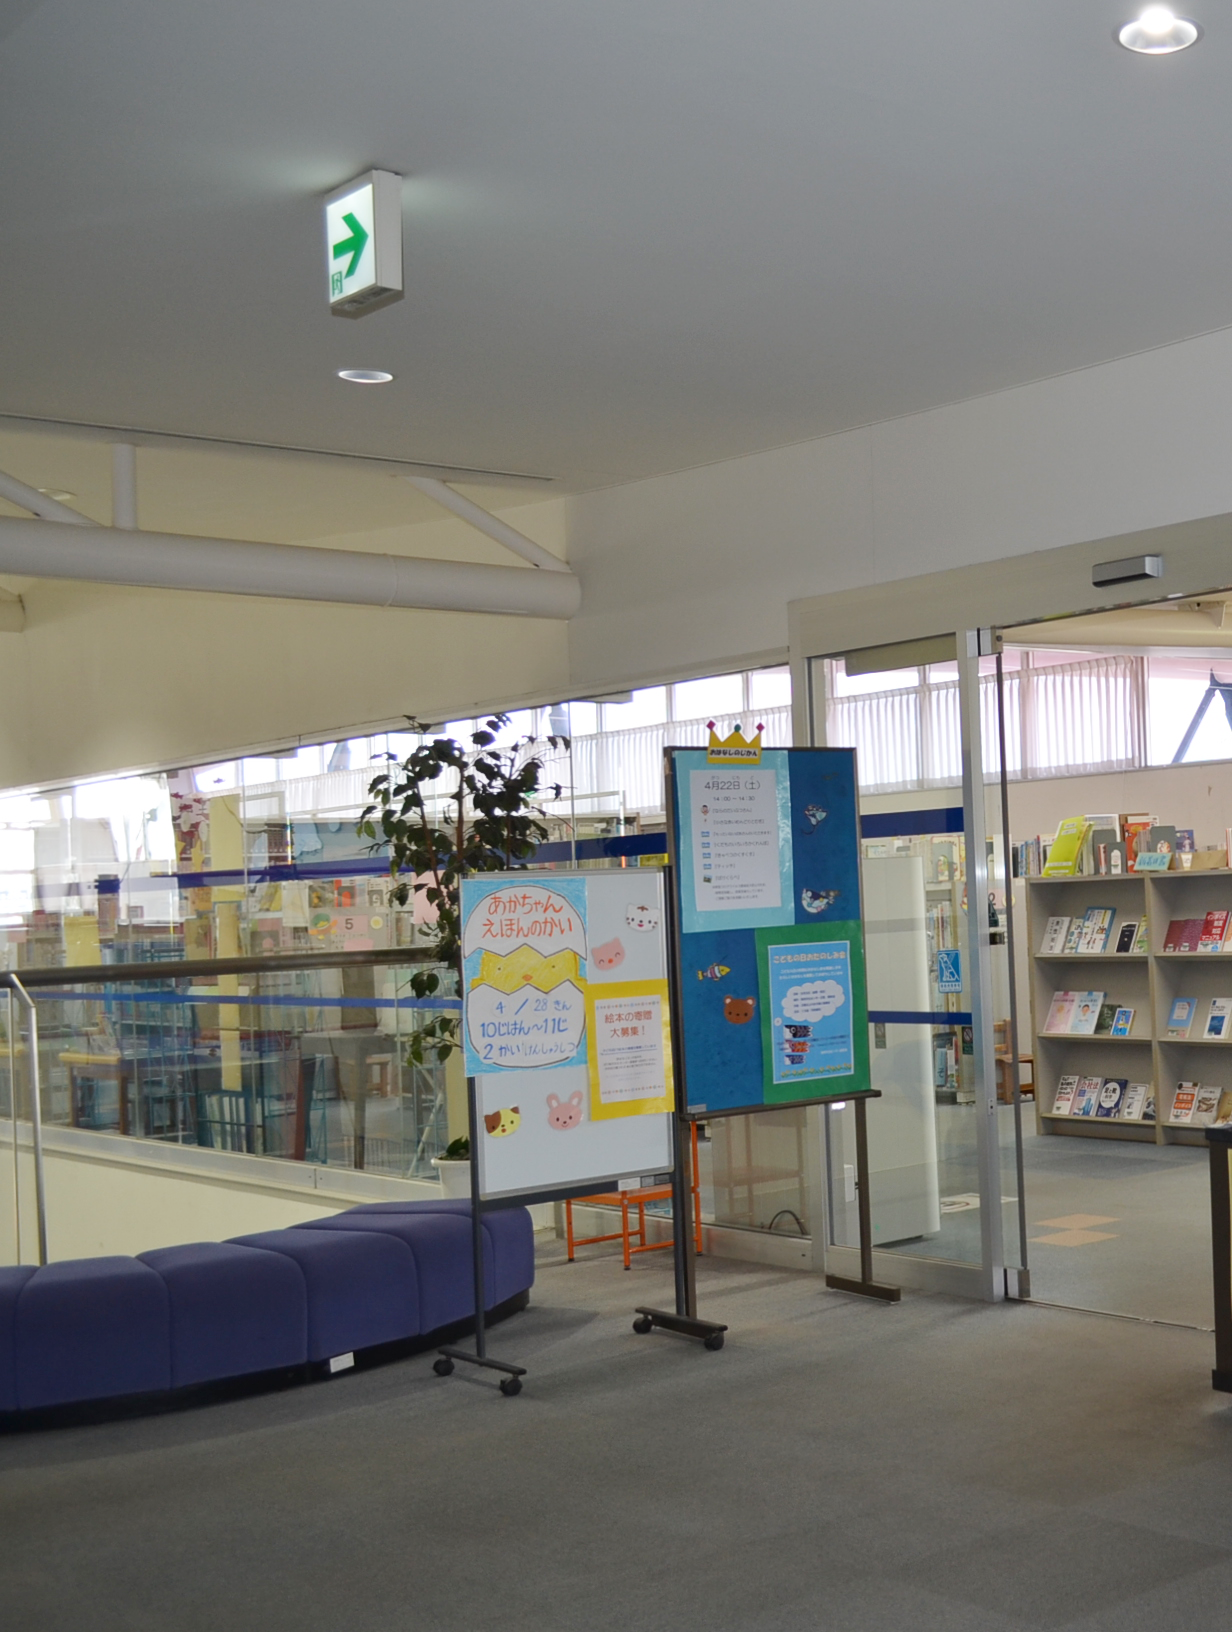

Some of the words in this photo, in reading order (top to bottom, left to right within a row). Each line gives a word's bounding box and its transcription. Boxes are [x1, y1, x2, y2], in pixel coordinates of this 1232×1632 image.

[709, 749, 758, 757] おはなしのじかん
[488, 893, 563, 915] あかちゃん
[345, 918, 354, 930] 5
[482, 917, 572, 938] えほんのかい
[774, 951, 846, 963] こどもの日おたのしみ会
[554, 999, 571, 1011] きん
[605, 1010, 652, 1024] 絵本の寄贈
[610, 1025, 645, 1038] 大募集！
